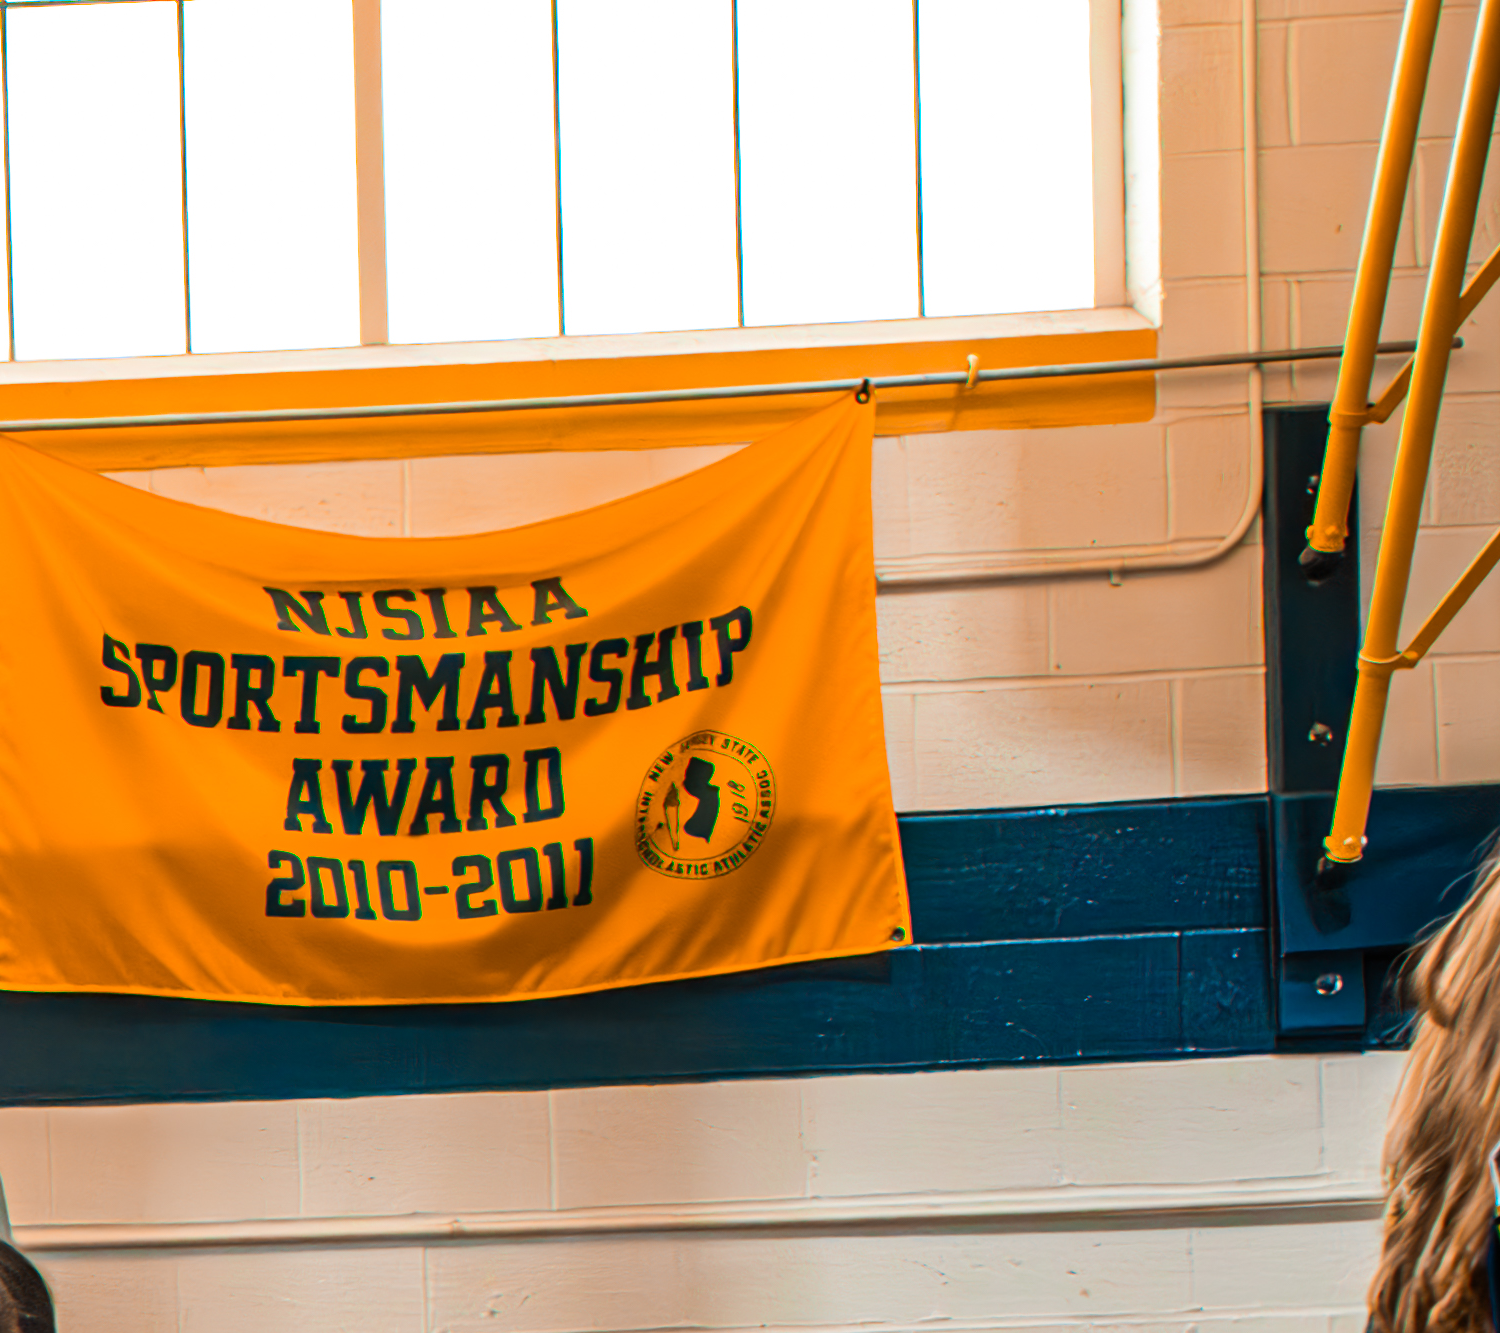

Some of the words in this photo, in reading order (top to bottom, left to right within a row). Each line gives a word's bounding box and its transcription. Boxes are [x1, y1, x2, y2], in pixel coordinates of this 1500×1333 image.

[263, 577, 589, 640] NJSIAA
[100, 606, 753, 733] SPORTSMANSHIP
[284, 747, 565, 836] AWARD
[720, 738, 759, 765] STATE
[265, 837, 593, 921] 2010-2011
